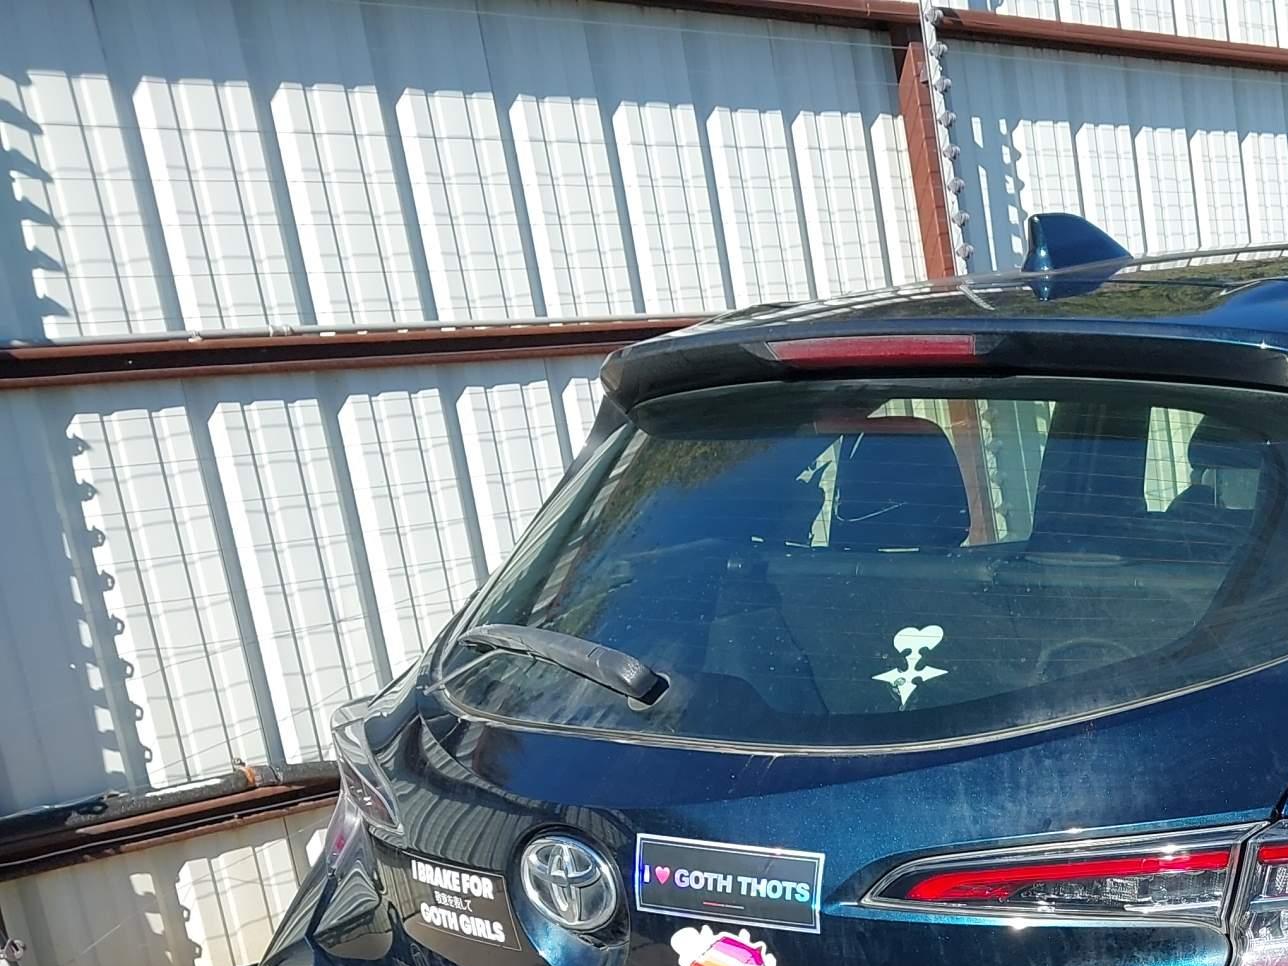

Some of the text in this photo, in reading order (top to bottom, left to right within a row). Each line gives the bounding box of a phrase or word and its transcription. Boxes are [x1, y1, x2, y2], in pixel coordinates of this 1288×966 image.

[411, 860, 495, 900] I BRAKE FOR
[643, 864, 810, 902] I GOTH THOTS
[420, 902, 506, 943] GOTH GIRLS
